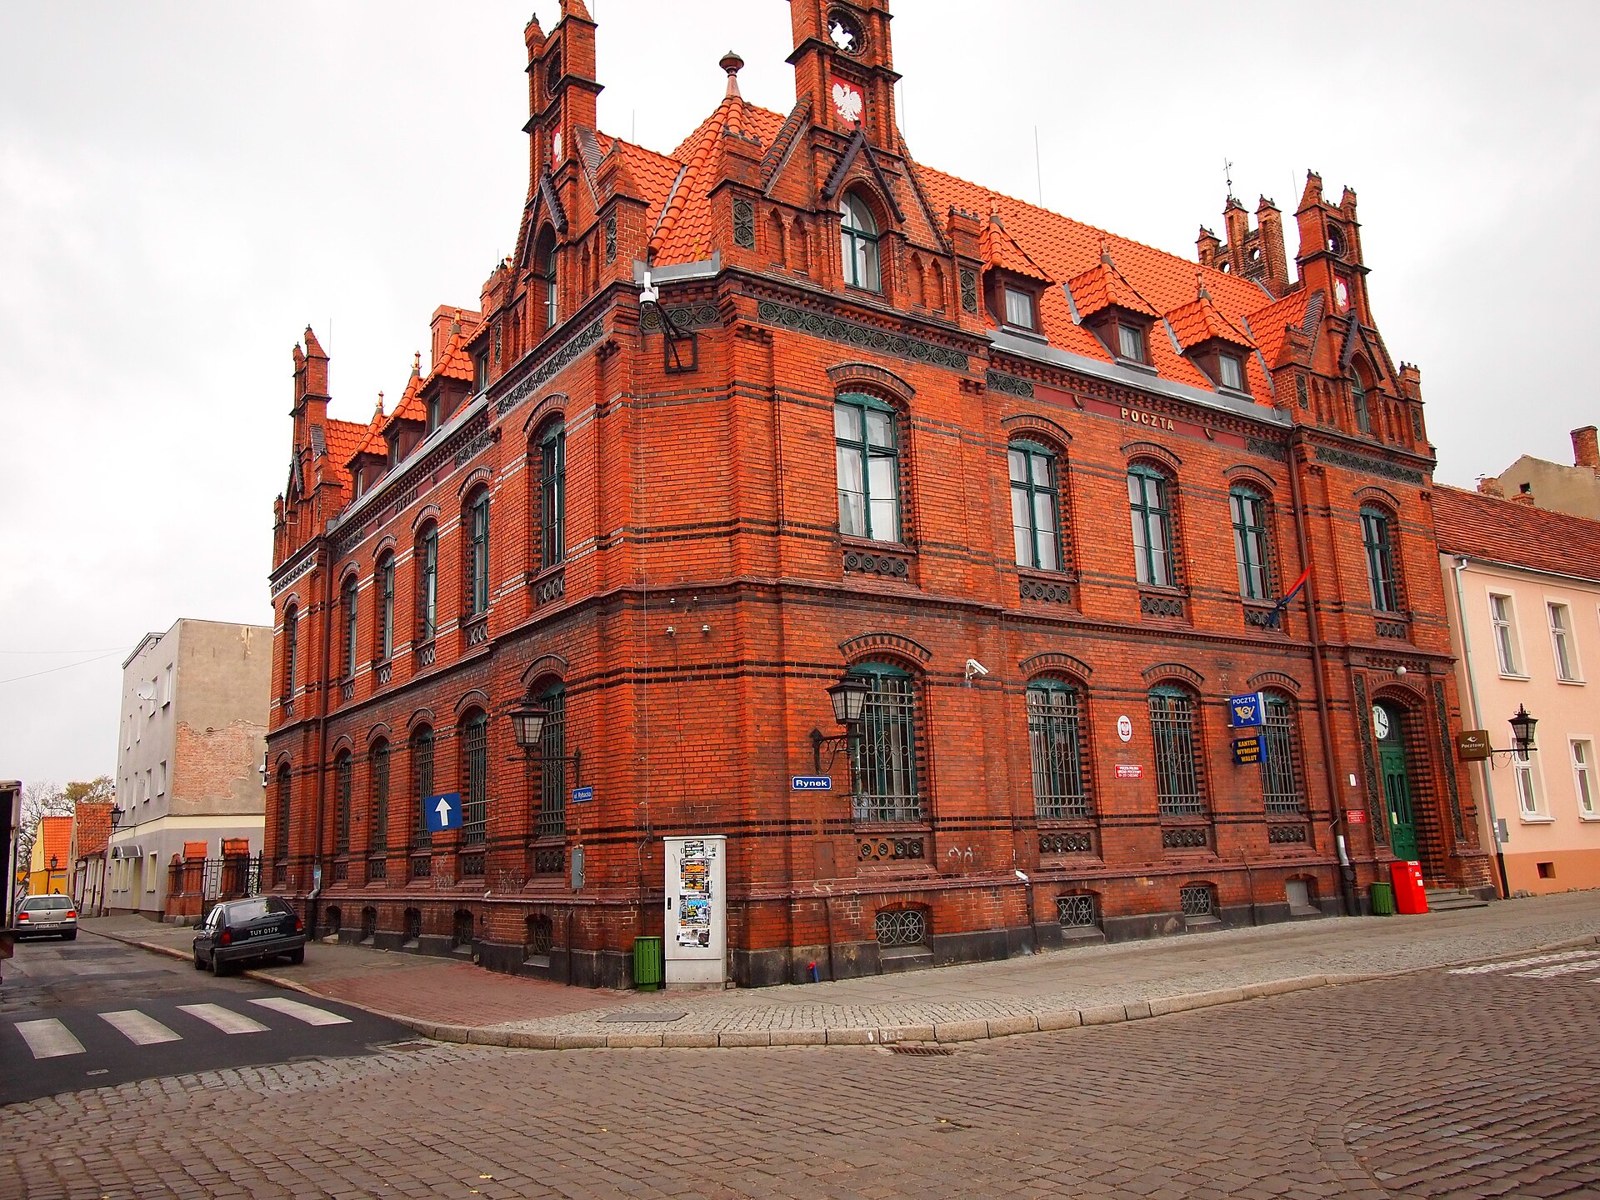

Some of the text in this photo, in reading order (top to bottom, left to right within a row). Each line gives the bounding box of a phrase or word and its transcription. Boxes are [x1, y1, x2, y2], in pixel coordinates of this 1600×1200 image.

[1121, 407, 1174, 431] POCZTA
[1233, 697, 1256, 705] POCZTA
[1237, 747, 1260, 755] WYMIANY
[796, 780, 828, 788] Rynek
